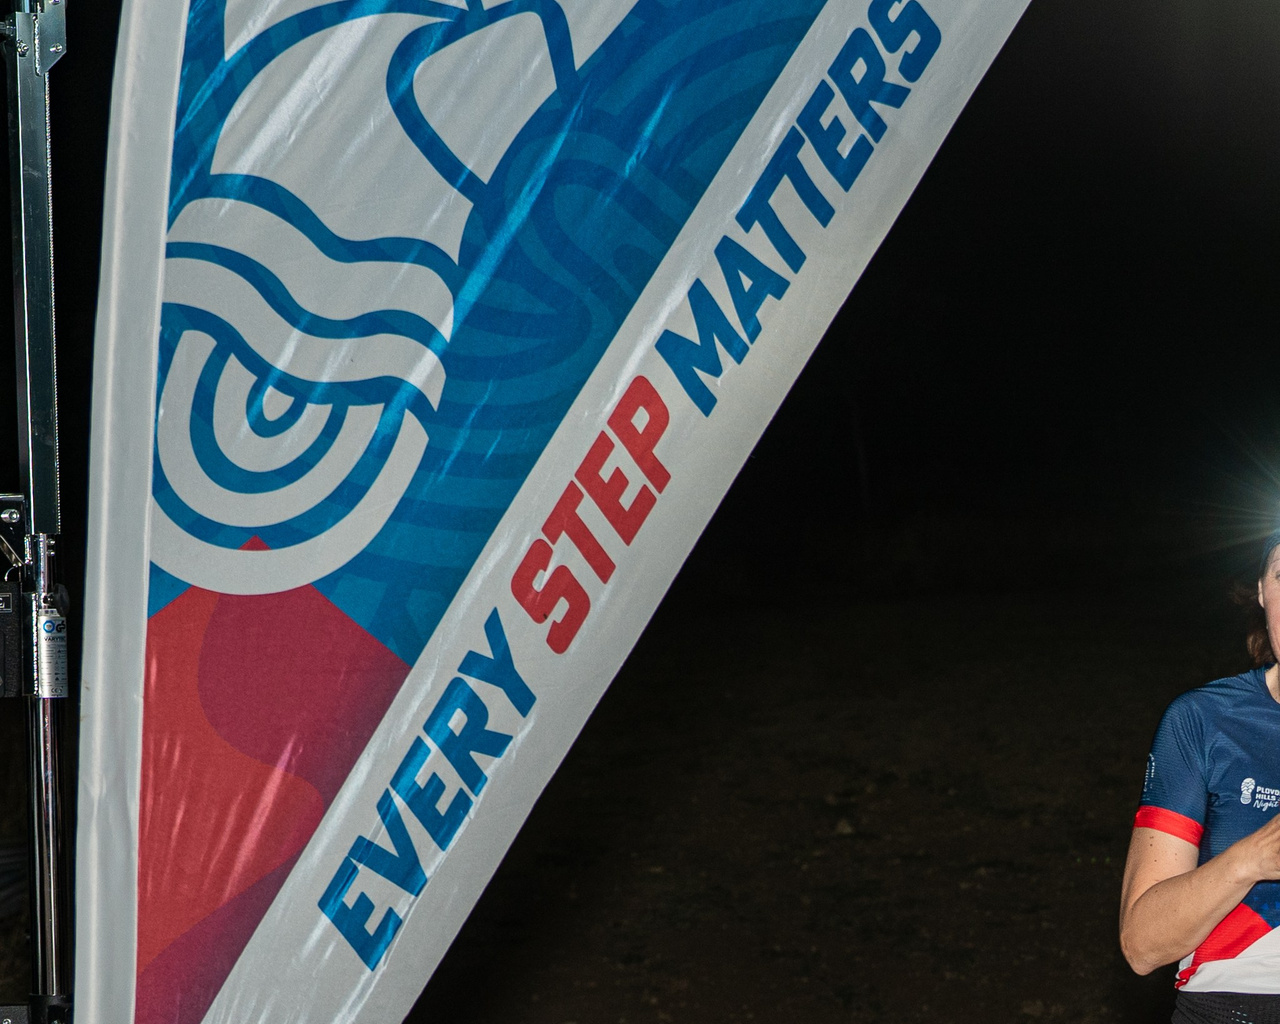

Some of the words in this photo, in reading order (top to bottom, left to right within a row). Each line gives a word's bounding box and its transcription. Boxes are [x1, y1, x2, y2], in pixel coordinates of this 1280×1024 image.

[317, 606, 538, 973] EVERY
[510, 374, 672, 655] STEP
[654, 0, 942, 418] MATTERS
[1255, 793, 1277, 802] HILLS
[1253, 800, 1279, 811] Night
